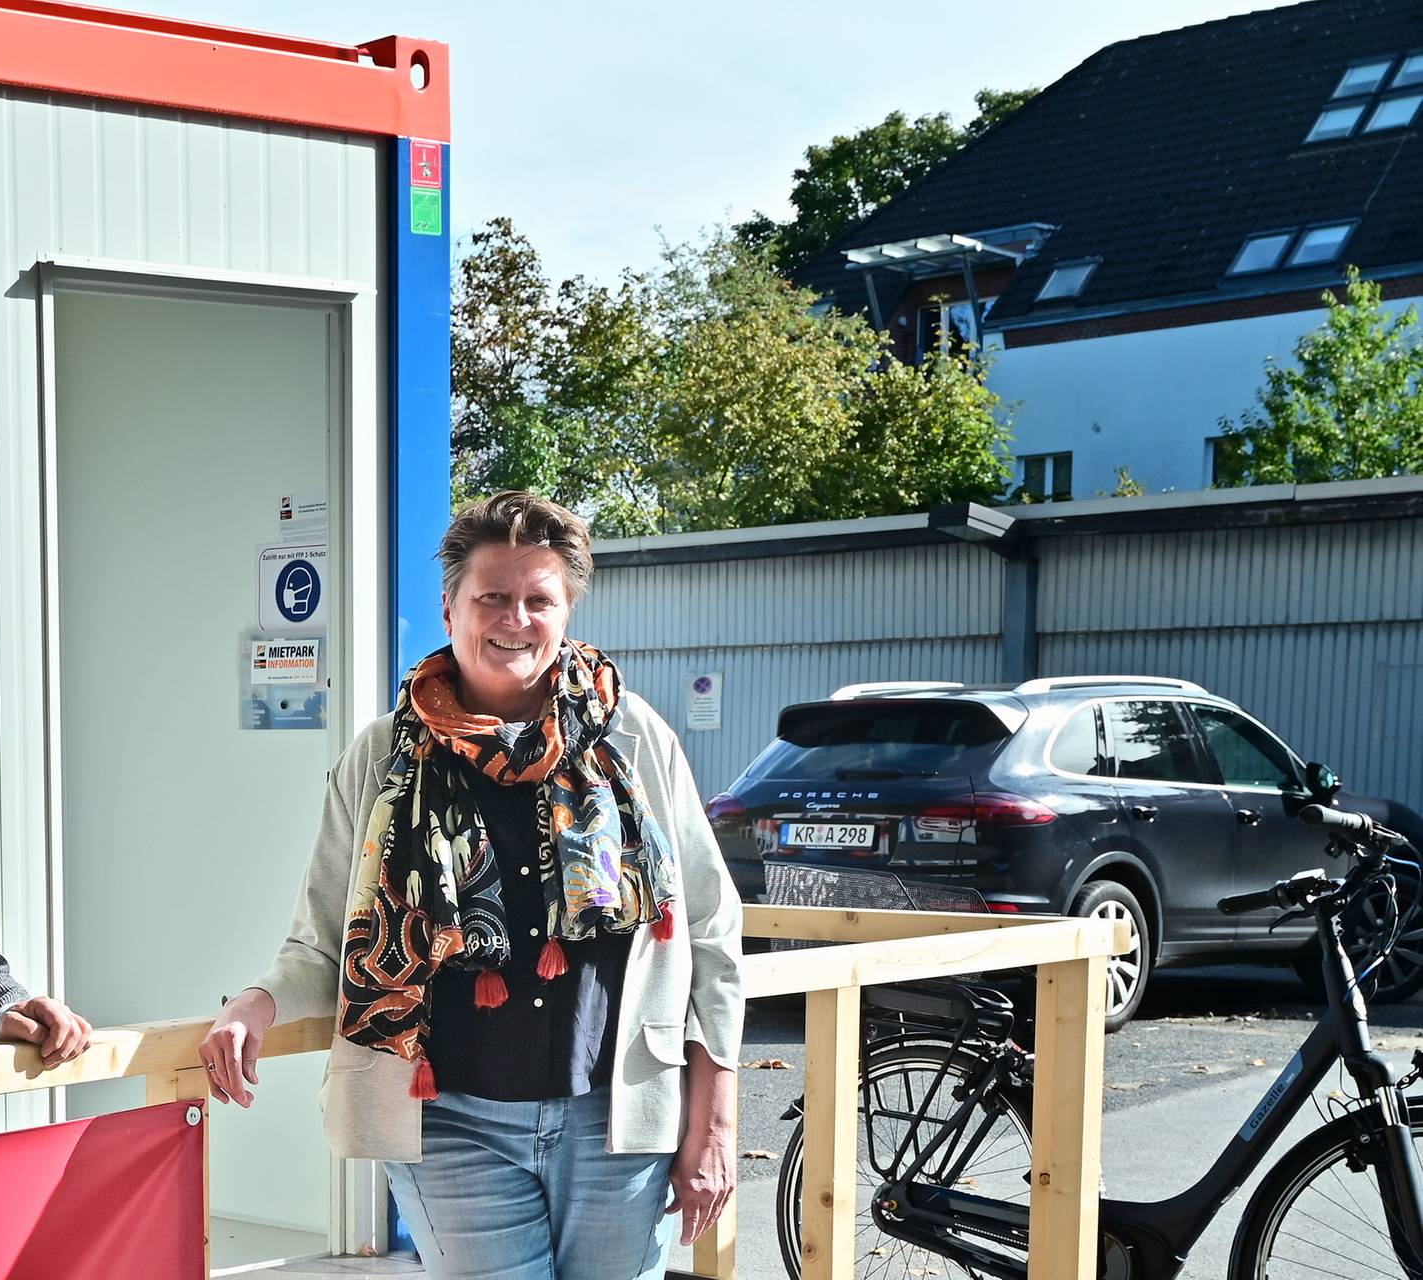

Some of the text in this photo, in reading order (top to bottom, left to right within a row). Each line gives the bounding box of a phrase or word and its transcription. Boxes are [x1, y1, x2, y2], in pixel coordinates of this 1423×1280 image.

[268, 646, 314, 658] MIETPARK
[268, 659, 314, 668] INFORMATION
[794, 826, 815, 843] KR
[825, 827, 834, 843] A
[838, 828, 867, 843] 298
[1250, 1083, 1286, 1129] Gazelle
